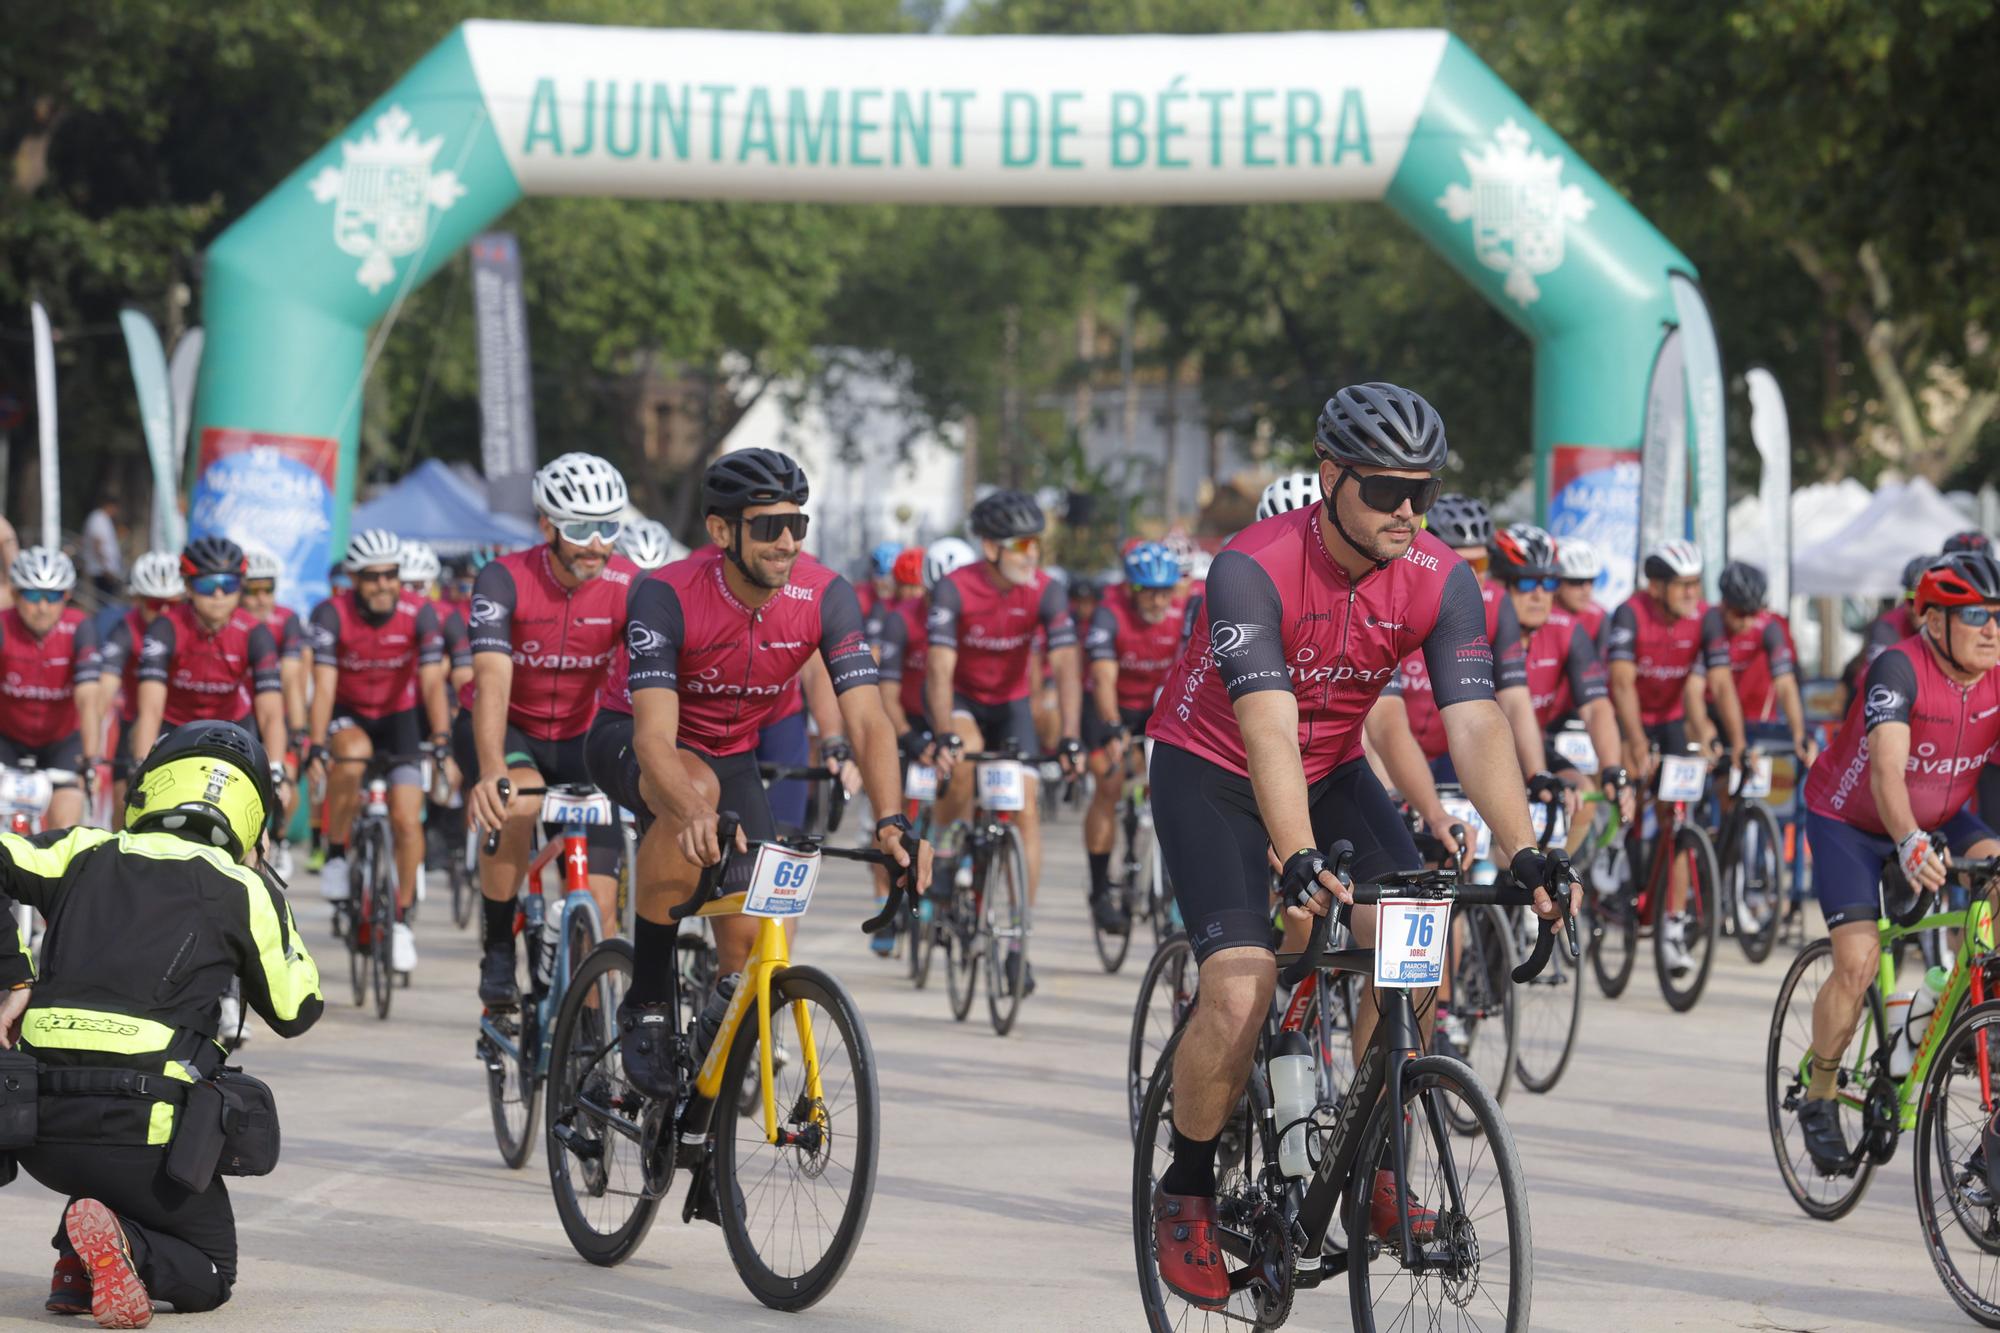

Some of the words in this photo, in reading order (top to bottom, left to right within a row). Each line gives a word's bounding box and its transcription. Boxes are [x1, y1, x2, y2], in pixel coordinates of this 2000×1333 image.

[523, 76, 976, 168] AJUNTAMENT
[1002, 91, 1084, 168] DE
[1110, 73, 1373, 168] BÉTERA
[555, 806, 599, 824] 430
[774, 861, 809, 888] 69
[1404, 913, 1435, 947] 76
[1410, 948, 1426, 957] JORGE
[35, 1014, 139, 1036] alpinestars
